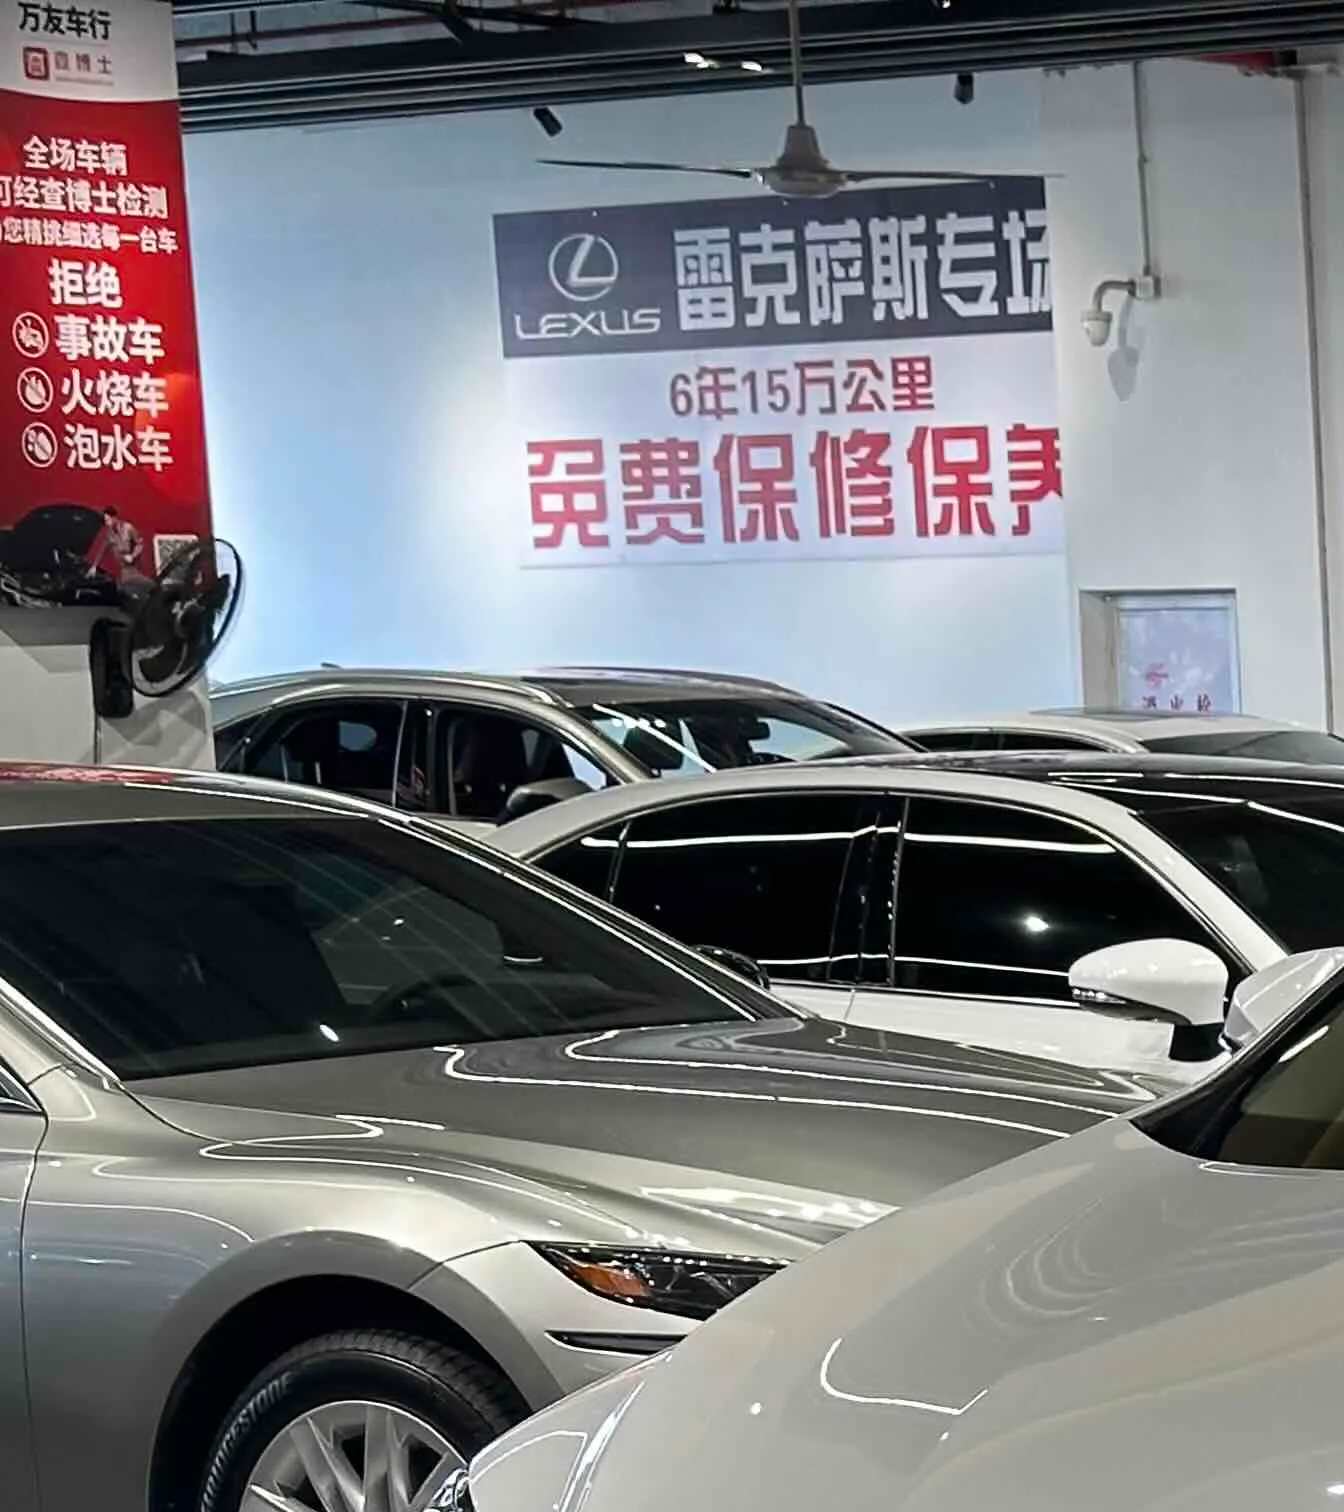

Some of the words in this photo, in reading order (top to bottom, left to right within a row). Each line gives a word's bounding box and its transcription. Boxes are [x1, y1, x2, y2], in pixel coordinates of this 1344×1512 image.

[18, 2, 111, 40] 万友车行
[23, 135, 128, 176] 全场车辆
[0, 216, 178, 254] 您精挑细选每一台车
[48, 257, 122, 308] 拒绝
[673, 208, 1053, 332] 雷克萨斯专场
[53, 313, 165, 365] 事故车
[514, 307, 661, 339] LEXUS
[61, 368, 169, 418] 火烧车
[669, 356, 934, 420] 6年15万公里
[64, 423, 173, 473] 泡水车
